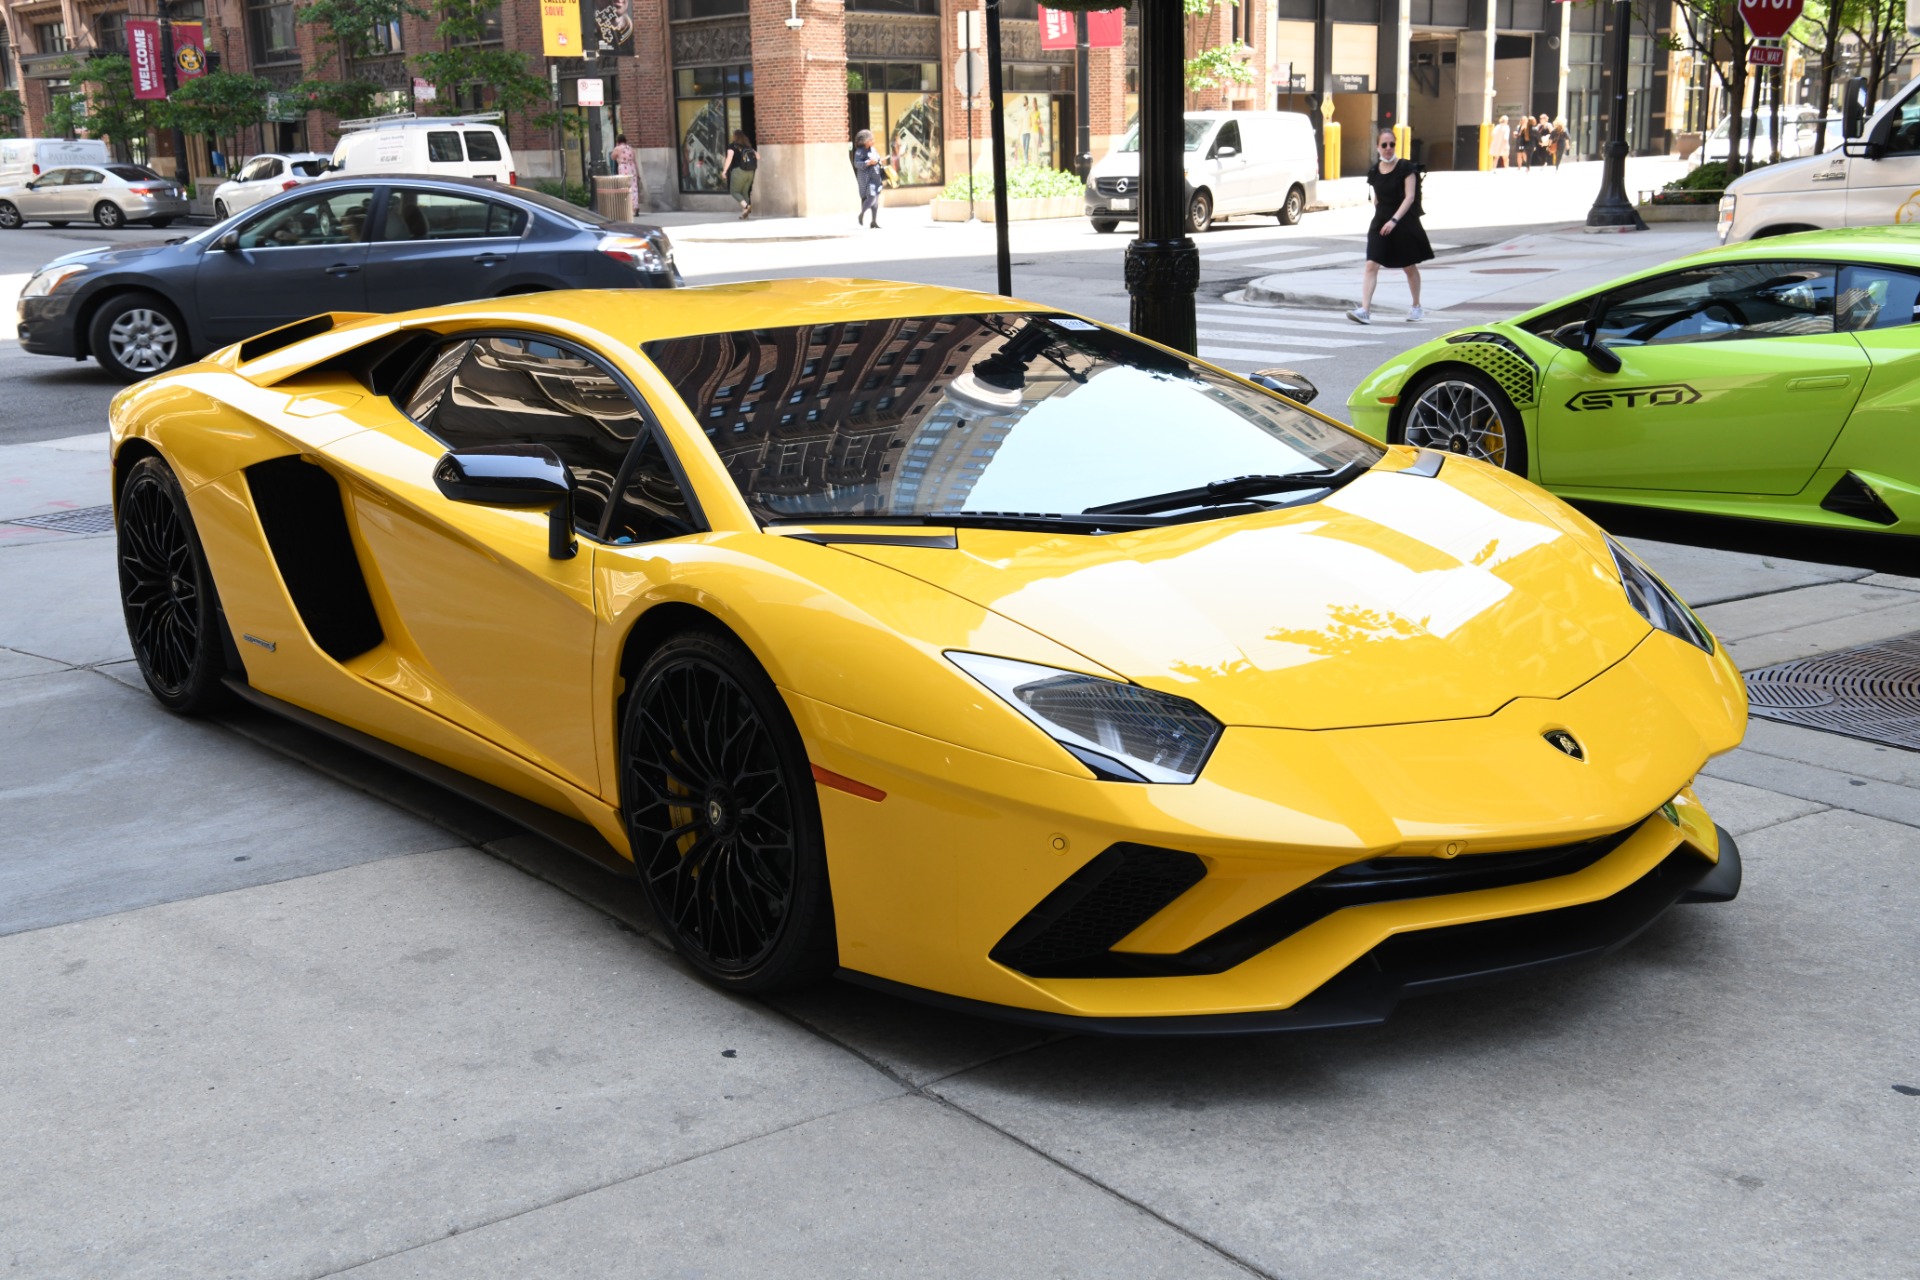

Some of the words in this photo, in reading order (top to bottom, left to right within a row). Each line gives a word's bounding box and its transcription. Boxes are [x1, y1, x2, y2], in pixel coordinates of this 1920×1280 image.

[544, 6, 564, 16] SOLVE
[147, 33, 155, 53] CAMPUS
[134, 29, 152, 91] WELCOME
[1752, 50, 1765, 61] ALL
[1767, 51, 1781, 62] WAY
[1582, 389, 1683, 410] STO
